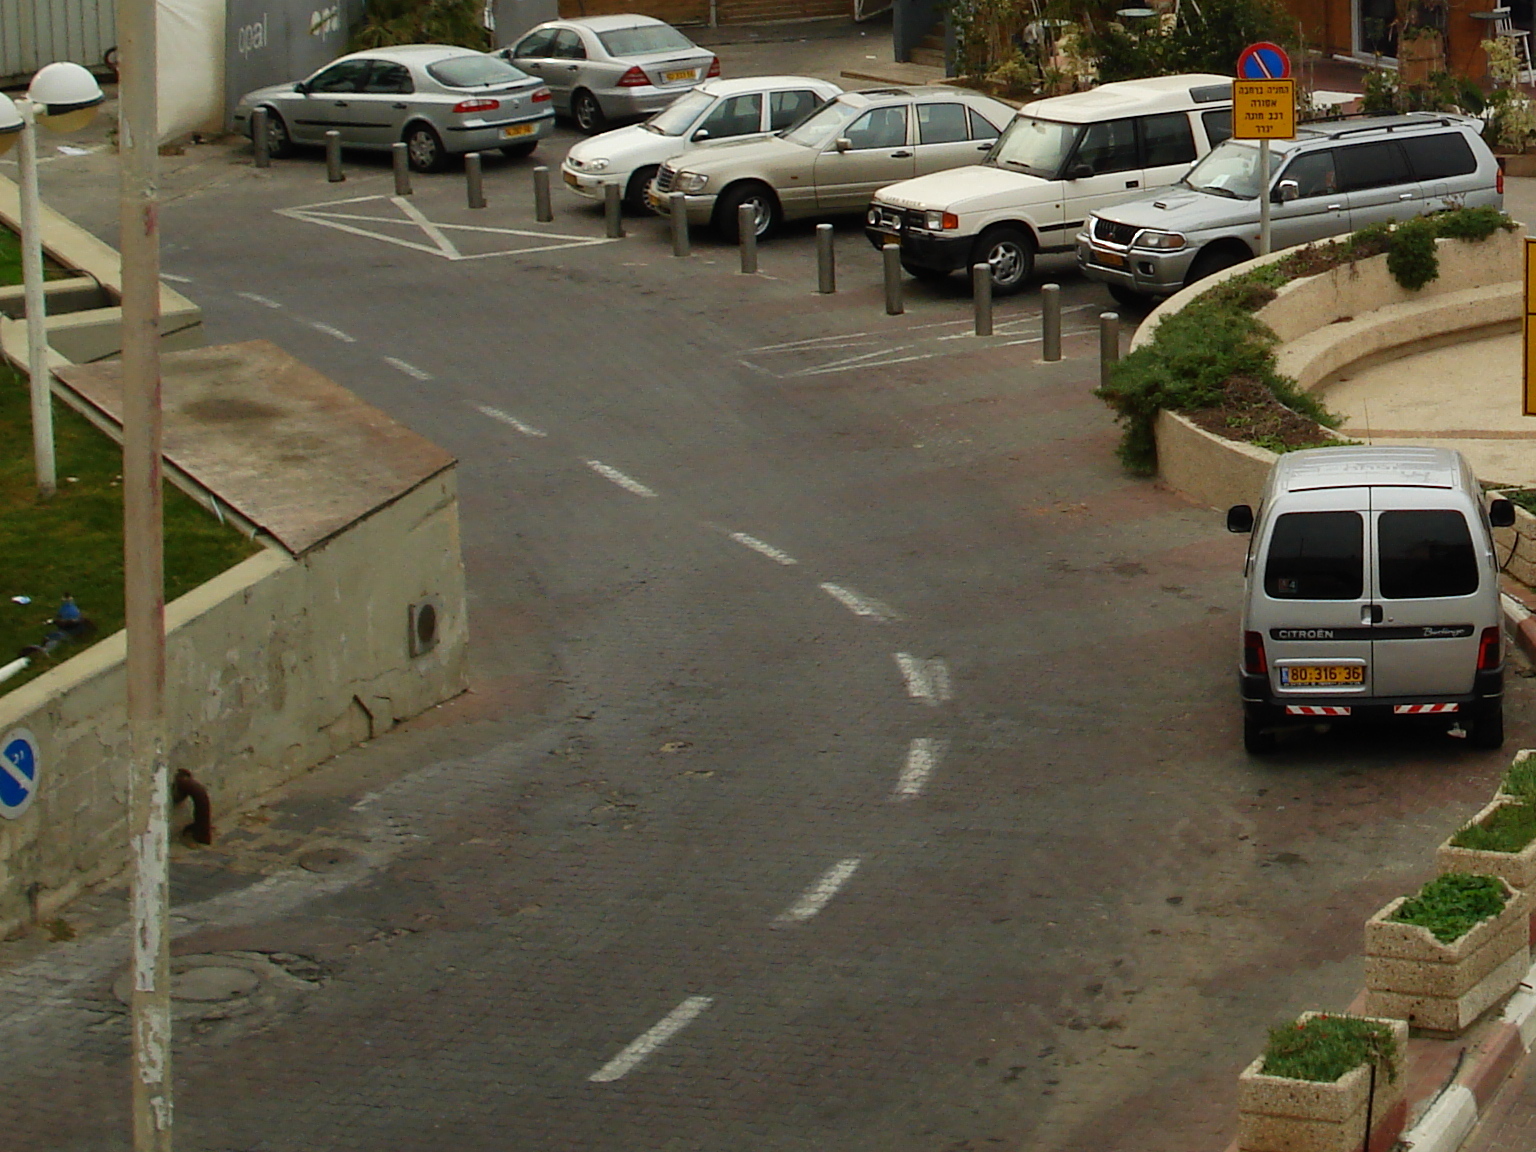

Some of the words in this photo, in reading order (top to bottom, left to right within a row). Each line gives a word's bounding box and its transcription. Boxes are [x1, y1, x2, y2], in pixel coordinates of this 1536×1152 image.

[238, 12, 267, 61] opal
[1245, 112, 1264, 120] חונה
[1269, 112, 1283, 120] רכב
[1278, 628, 1334, 639] CITROËN
